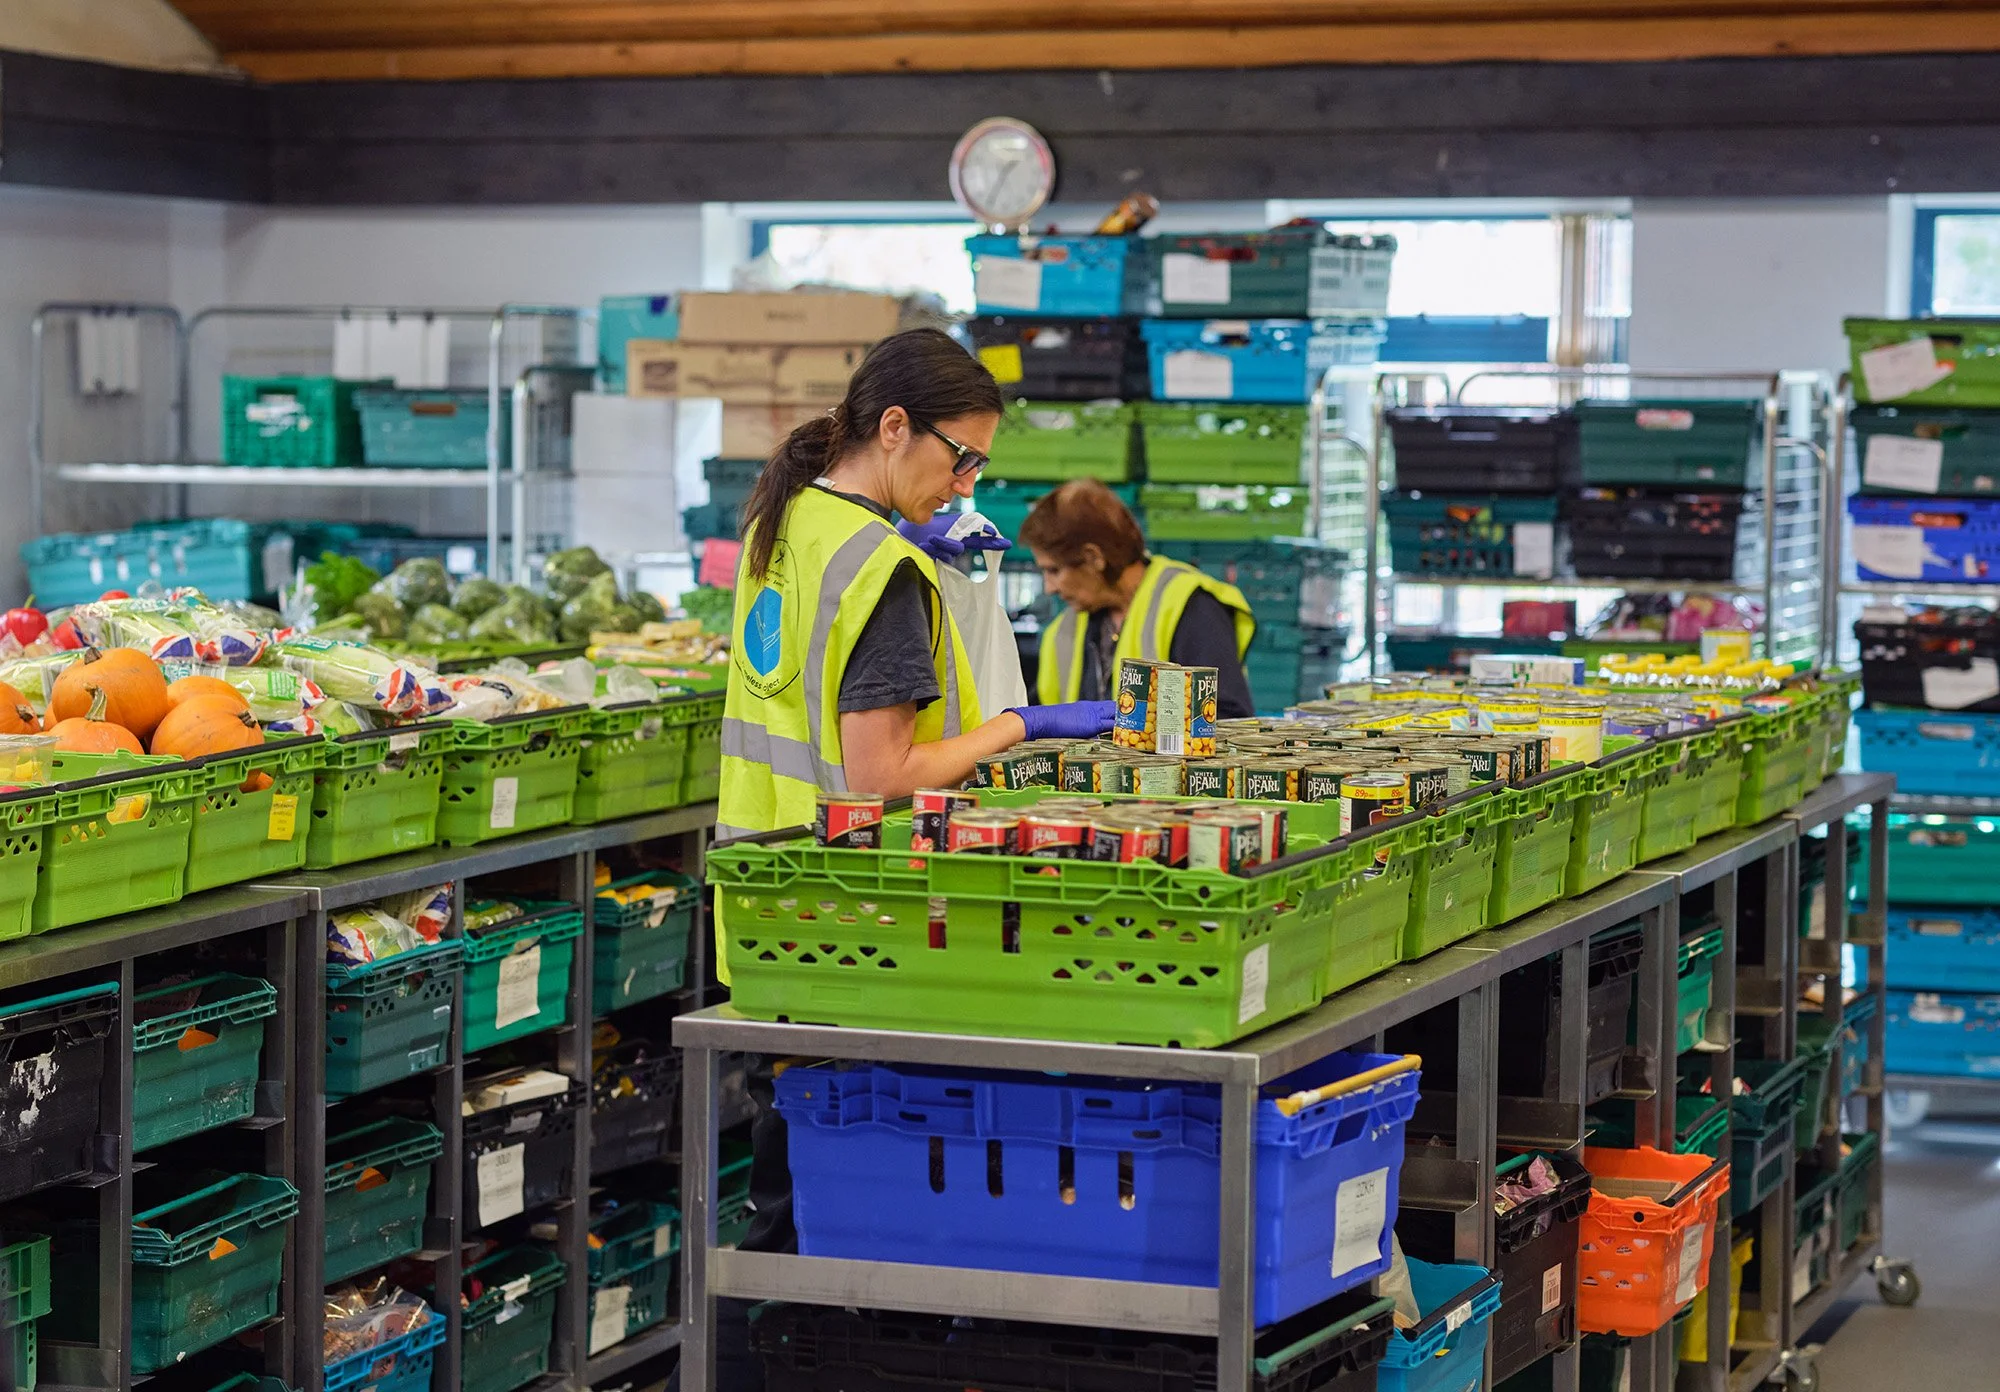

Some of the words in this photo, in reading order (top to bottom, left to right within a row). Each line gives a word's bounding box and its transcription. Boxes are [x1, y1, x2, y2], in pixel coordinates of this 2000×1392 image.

[1035, 761, 1054, 775] ARL
[1470, 759, 1490, 772] ARL
[1189, 775, 1221, 796] PEARL
[1248, 777, 1280, 799] PEARL
[1307, 780, 1338, 802] PEARL
[848, 811, 874, 827] PEARL
